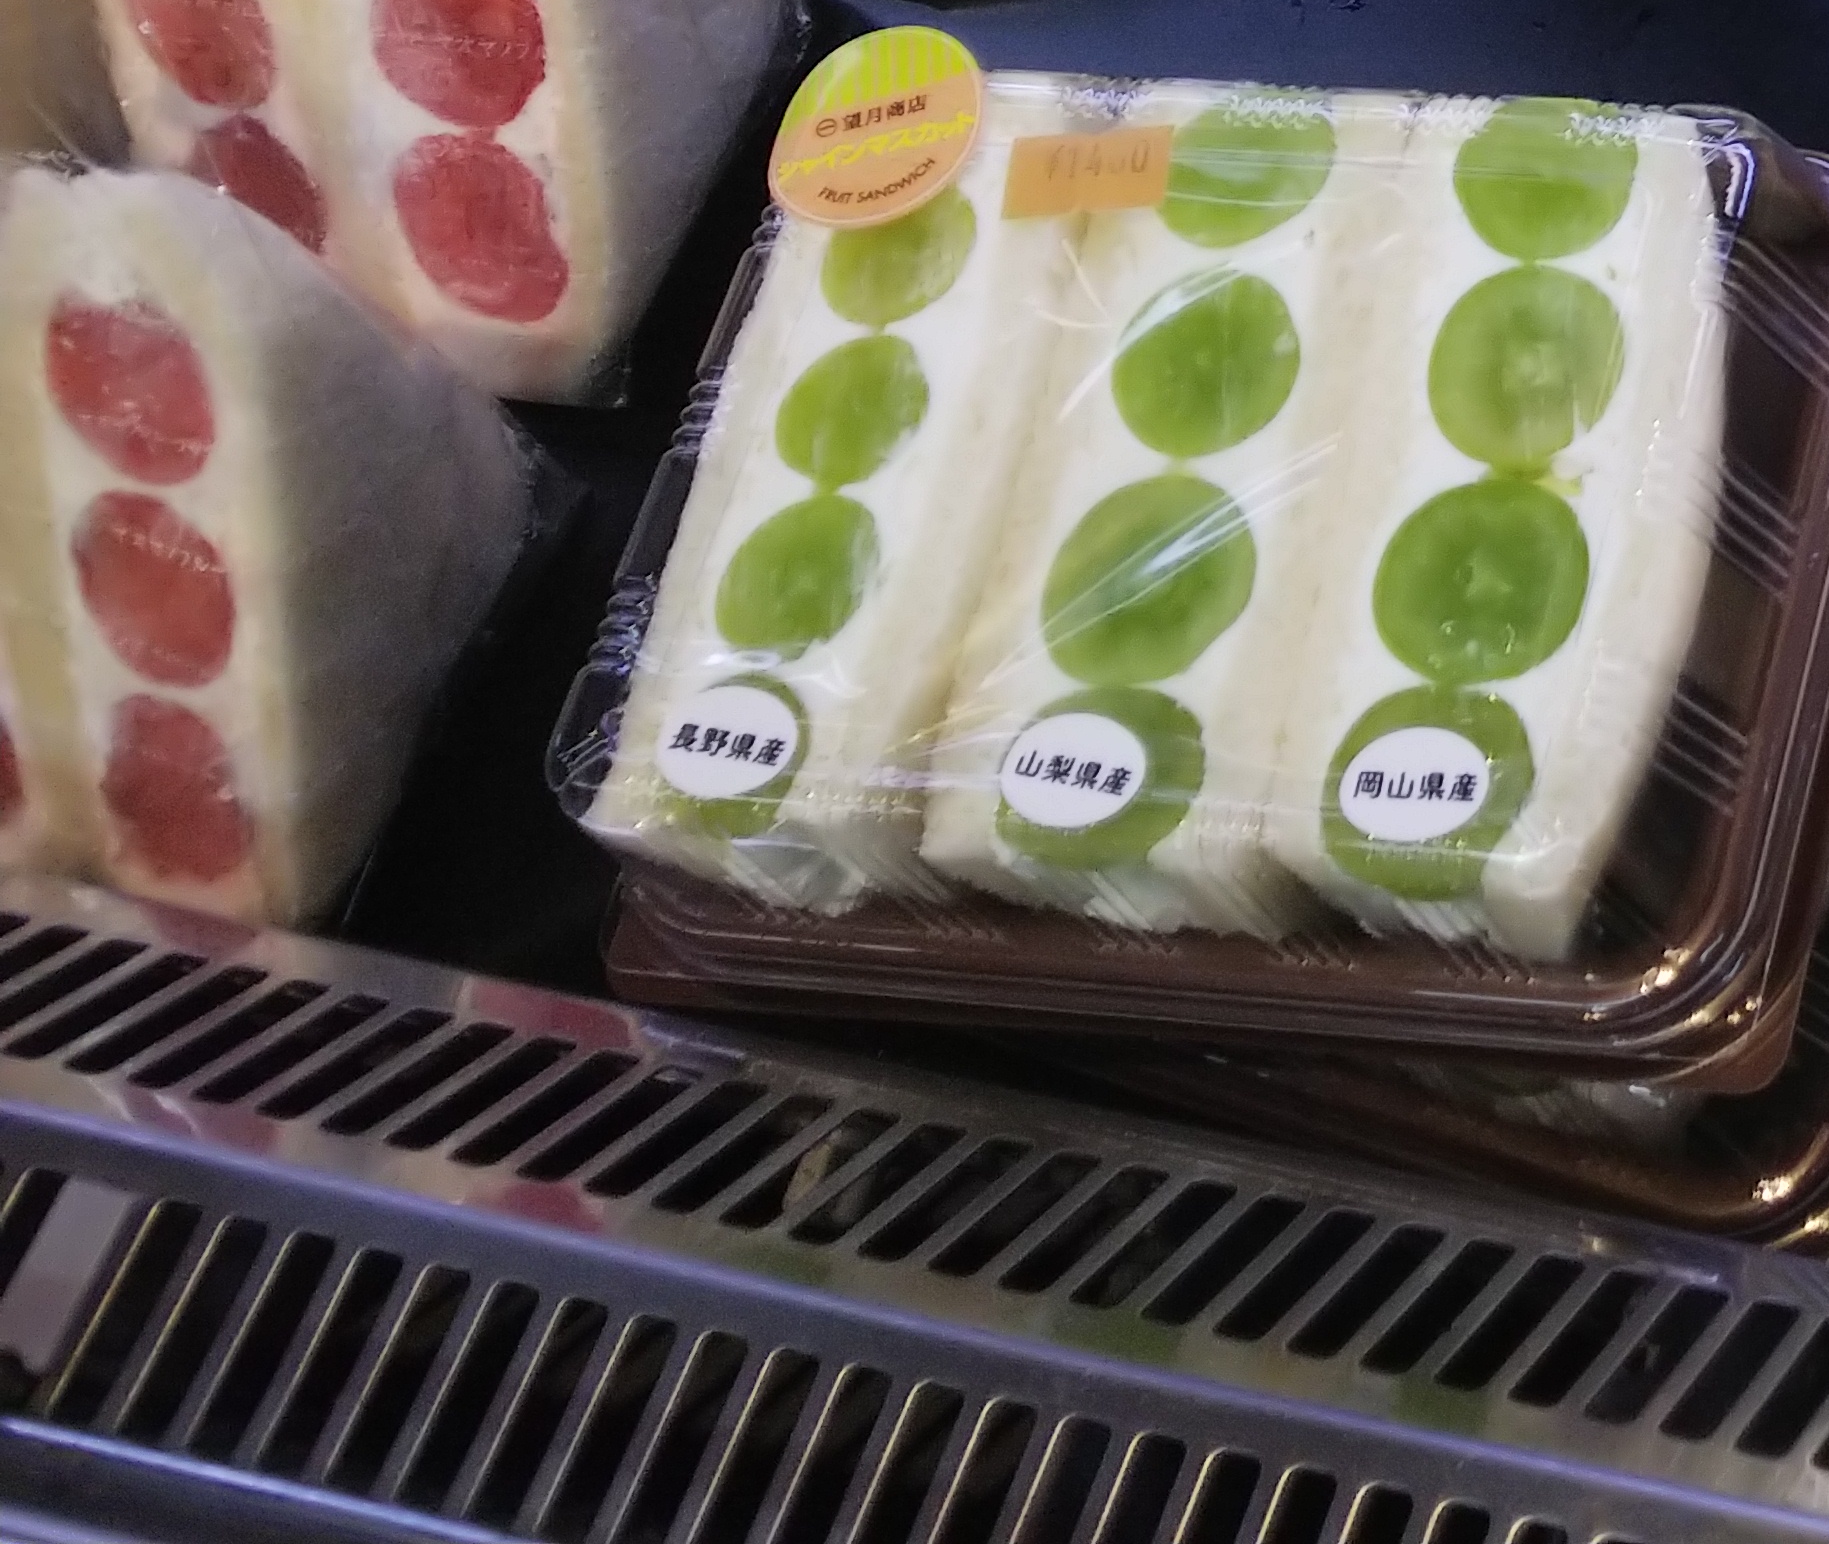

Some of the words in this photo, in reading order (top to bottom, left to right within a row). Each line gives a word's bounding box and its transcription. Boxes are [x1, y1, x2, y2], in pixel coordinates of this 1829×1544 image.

[842, 94, 928, 131] 望月商店
[778, 110, 975, 184] シャインマスカット
[818, 185, 852, 205] FRUIT
[857, 157, 936, 204] SANDWICH
[668, 722, 788, 768] 長野県産
[1014, 747, 1137, 796] 山梨県産
[1351, 771, 1478, 804] 岡山県産
